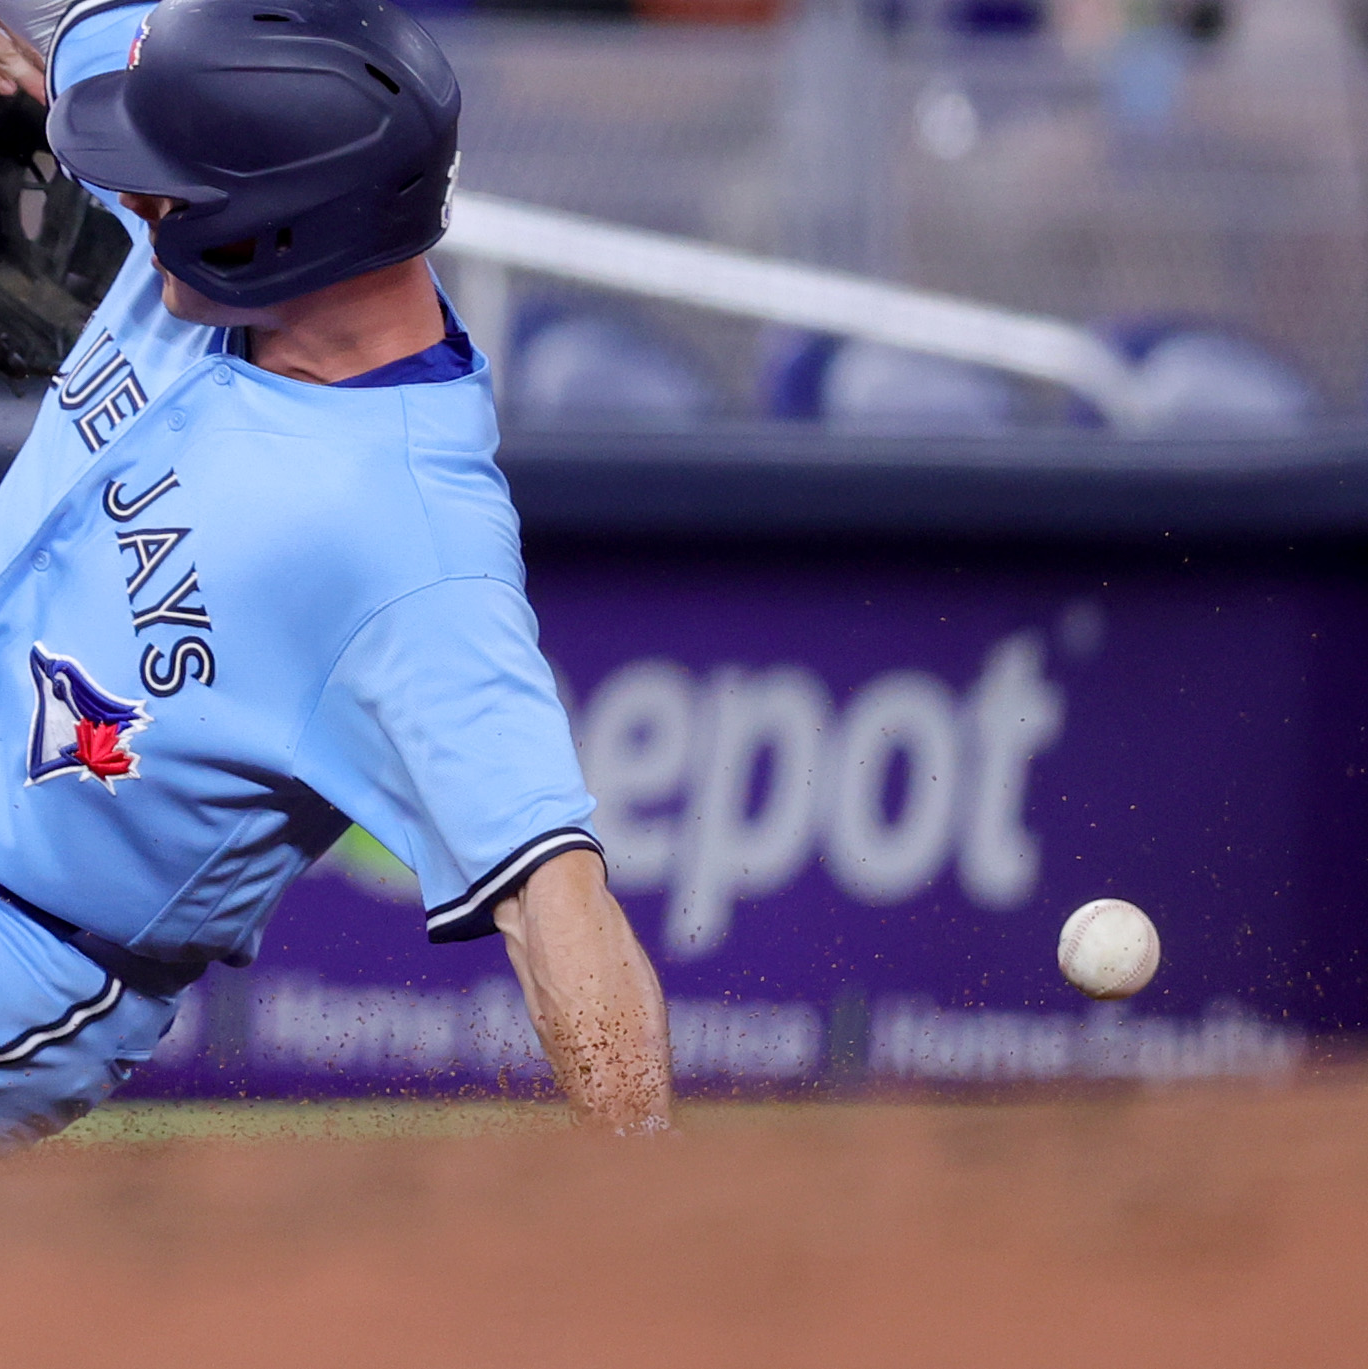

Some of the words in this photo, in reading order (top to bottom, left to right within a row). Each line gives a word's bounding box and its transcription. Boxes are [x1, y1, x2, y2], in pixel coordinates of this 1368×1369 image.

[52, 326, 149, 454] UE
[102, 466, 215, 698] JAYS
[303, 632, 1063, 962] epot
